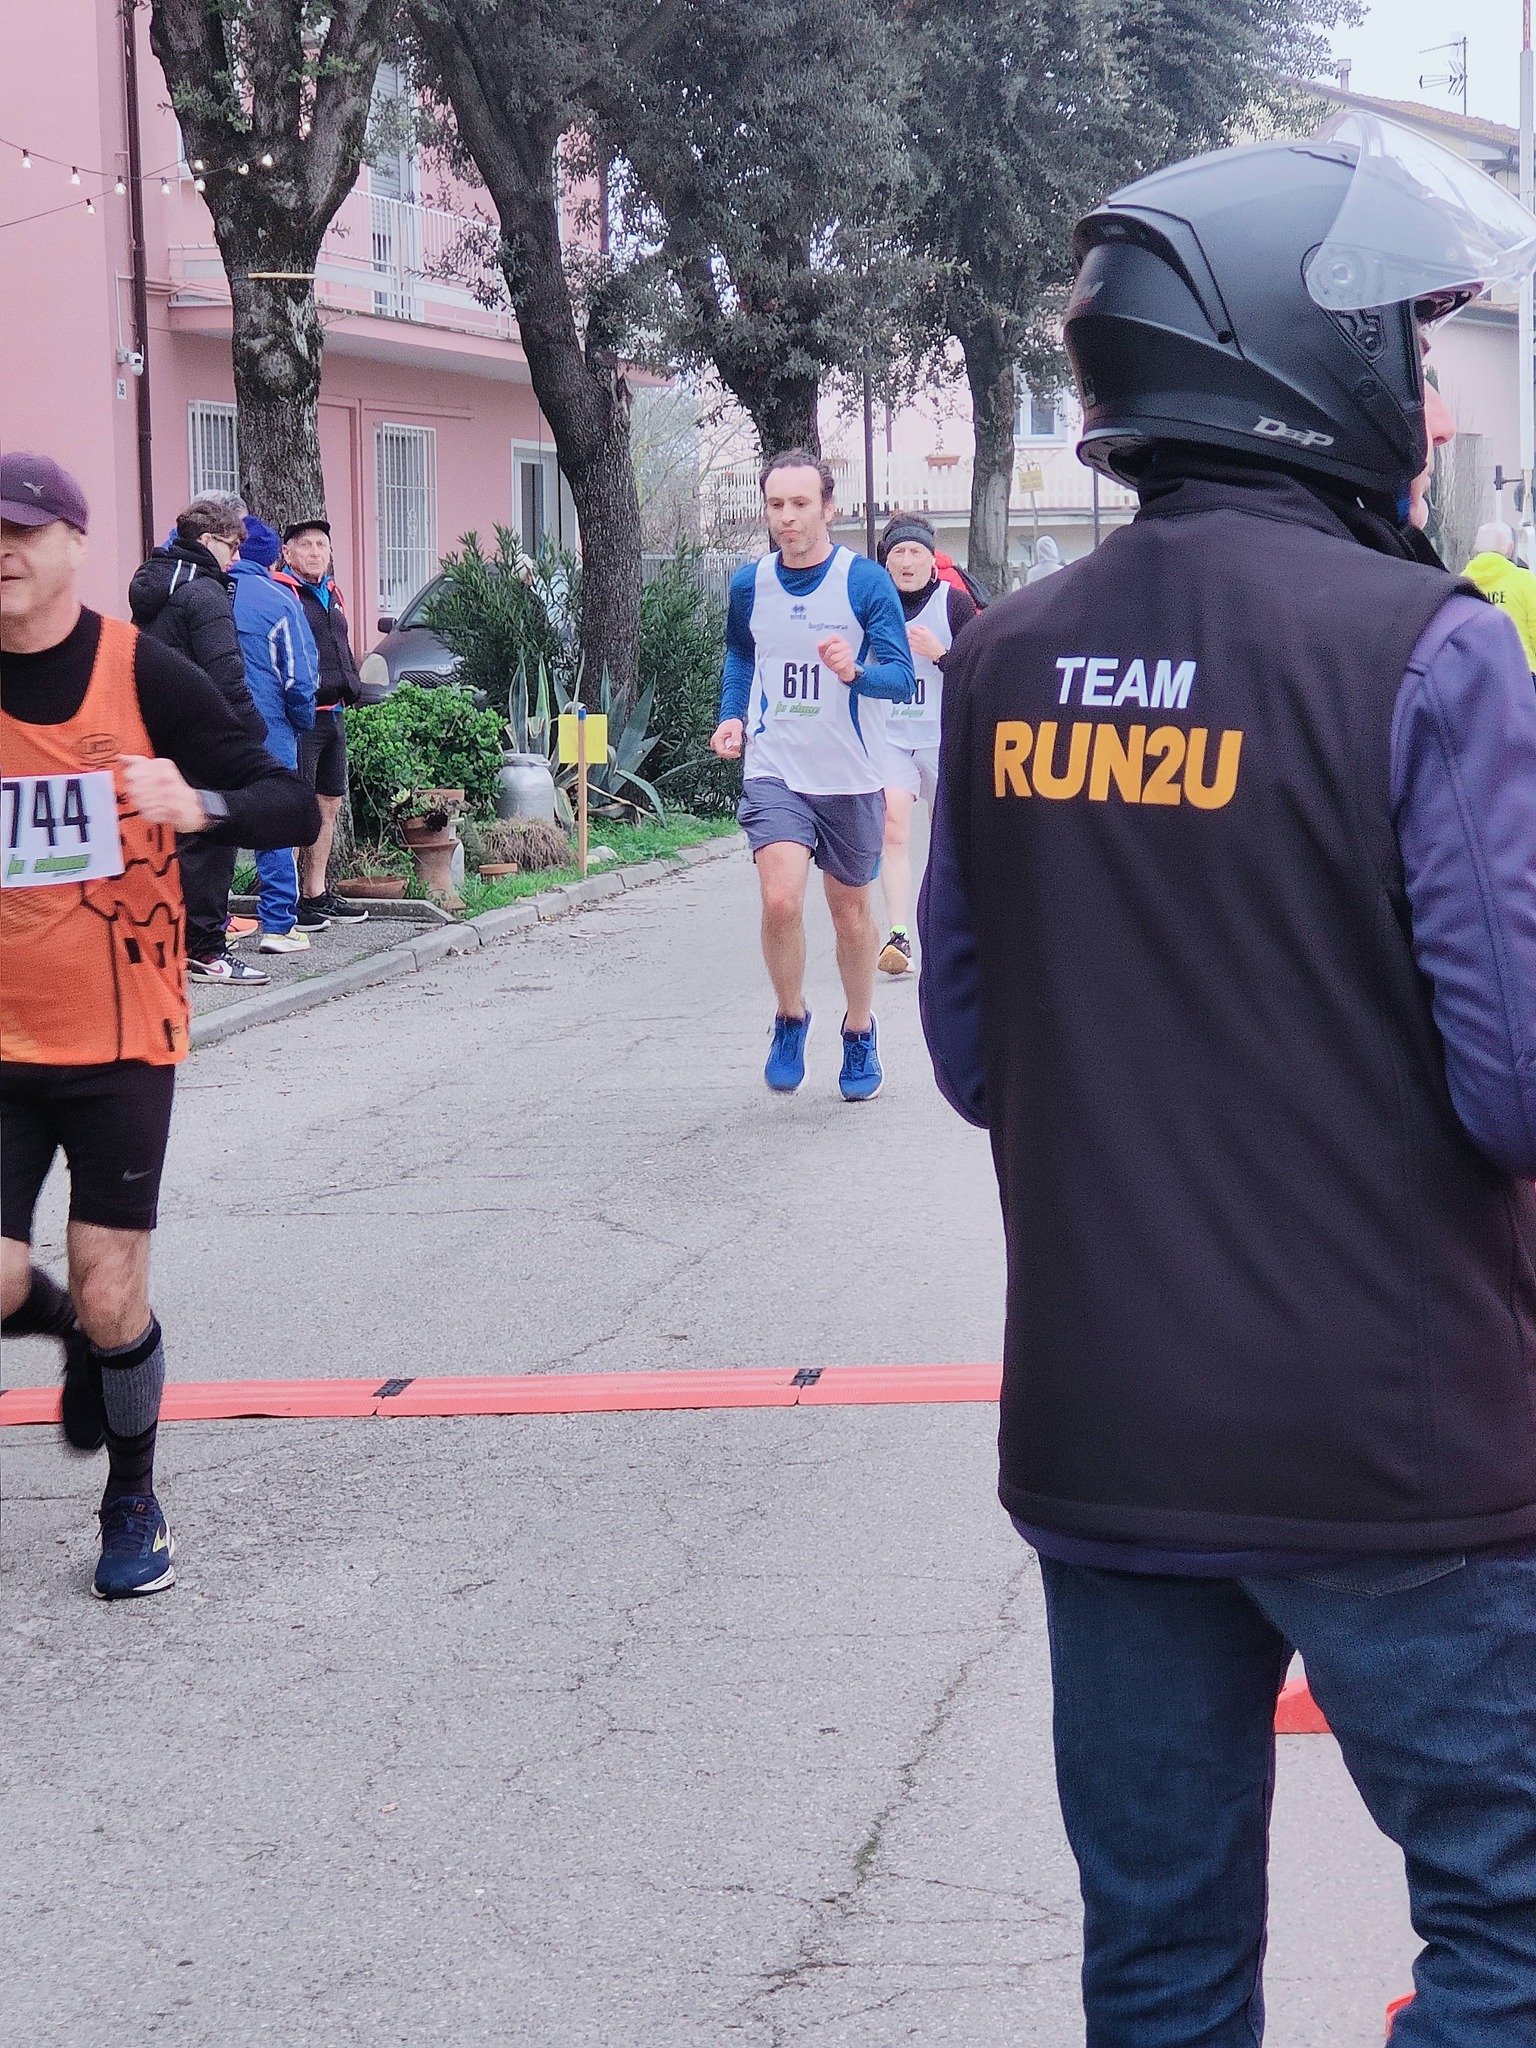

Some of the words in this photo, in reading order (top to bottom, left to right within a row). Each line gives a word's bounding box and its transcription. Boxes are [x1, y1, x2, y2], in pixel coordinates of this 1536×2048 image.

[783, 662, 820, 700] 611
[1056, 656, 1197, 709] TEAM
[993, 720, 1245, 810] RUN2U
[2, 779, 90, 849] 744
